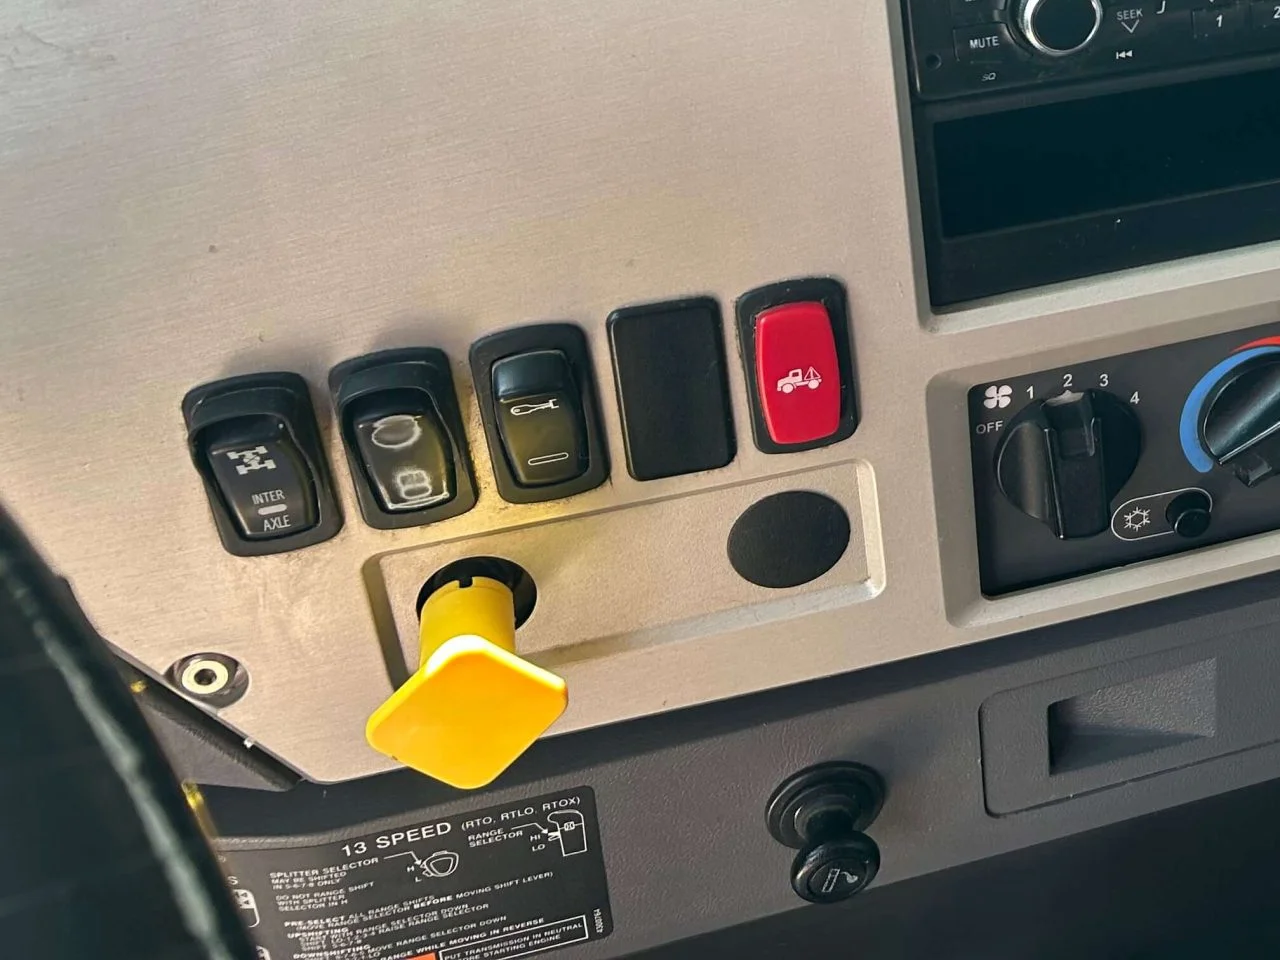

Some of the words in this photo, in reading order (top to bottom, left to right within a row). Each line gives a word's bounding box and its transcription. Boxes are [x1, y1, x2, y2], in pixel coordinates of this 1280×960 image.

[1116, 8, 1143, 21] SEEK
[1215, 15, 1223, 27] 1
[969, 36, 1000, 49] MUTE
[1063, 374, 1073, 387] 2
[1099, 373, 1109, 387] 3
[1026, 386, 1034, 399] 1
[1129, 391, 1140, 405] 4
[976, 420, 1003, 435] OFF
[251, 489, 286, 505] INTER
[263, 515, 291, 531] AXLE
[341, 841, 368, 858] 13
[376, 821, 452, 850] SPEED
[542, 795, 581, 812] RTOX)
[467, 827, 504, 841] RANGE
[529, 834, 541, 842] HI
[468, 830, 524, 848] SELECTOR
[532, 843, 546, 852] LO
[269, 867, 319, 880] SPLITTER
[322, 857, 379, 874] SELECTOR
[308, 871, 347, 883] SHIFTED
[317, 878, 342, 887] ONLY
[291, 892, 310, 900] NOT
[314, 888, 345, 898] RANGE
[349, 881, 375, 892] SHIFT
[276, 898, 299, 906] WITH
[302, 894, 345, 905] SPLITTER
[278, 902, 325, 912] SELECTOR
[328, 918, 359, 928] RANGE
[363, 906, 411, 921] SELECTOR
[413, 895, 453, 909] BEFORE
[455, 886, 492, 899] MOVING
[494, 879, 520, 890] SHIFT
[522, 871, 553, 884] LEVER)
[349, 912, 364, 920] ALL
[368, 904, 399, 915] RANGE
[402, 894, 435, 907] SHIFTS
[356, 922, 388, 934] RANGE
[390, 910, 438, 925] SELECTOR
[440, 903, 469, 914] DOWN
[378, 924, 406, 934] RAISE
[408, 915, 439, 927] RANGE
[442, 903, 489, 920] SELECTOR
[287, 926, 350, 939] UPSHIFTING
[368, 943, 393, 955] MOVE
[396, 934, 429, 946] RANGE
[431, 923, 477, 941] SELECTOR
[479, 916, 507, 927] DOWN
[416, 942, 446, 954] WHILE
[449, 932, 488, 945] MOVING
[502, 917, 545, 932] REVERSE
[464, 935, 530, 956] TRANSMISSION
[532, 932, 542, 940] IN
[544, 923, 583, 937] NEUTRAL
[293, 944, 371, 959] DOWNSHIFTING
[484, 943, 526, 958] STARTING
[528, 933, 562, 947] ENGINE
